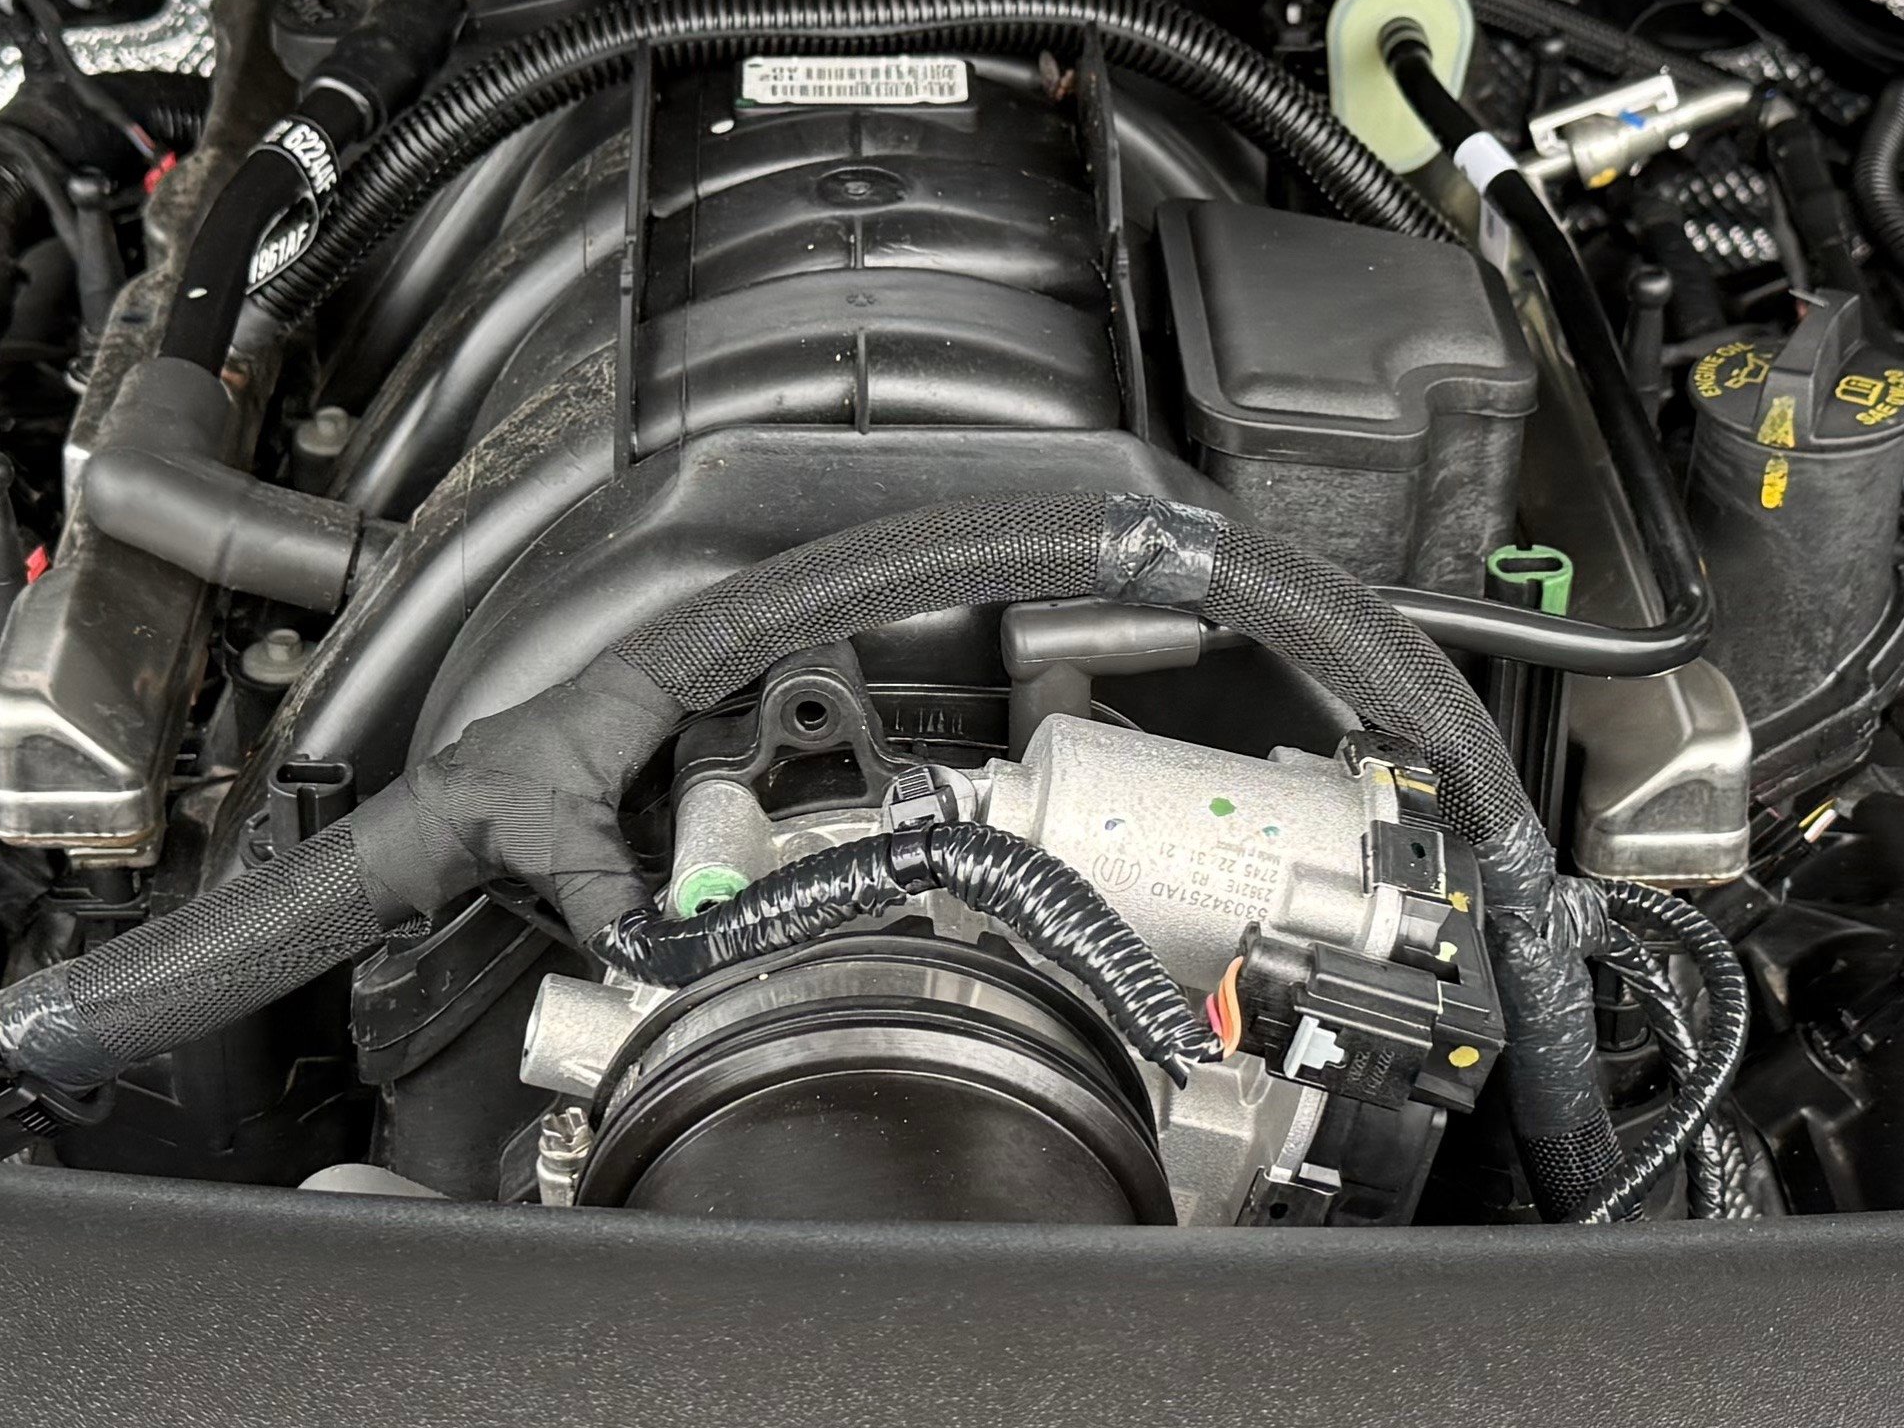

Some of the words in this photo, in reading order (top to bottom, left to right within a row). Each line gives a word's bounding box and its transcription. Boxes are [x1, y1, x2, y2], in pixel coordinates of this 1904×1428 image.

[1694, 355, 1725, 398] ENGINE
[1715, 341, 1756, 358] OIL
[1855, 401, 1899, 426] SAE
[1151, 881, 1269, 922] 53034251AD
